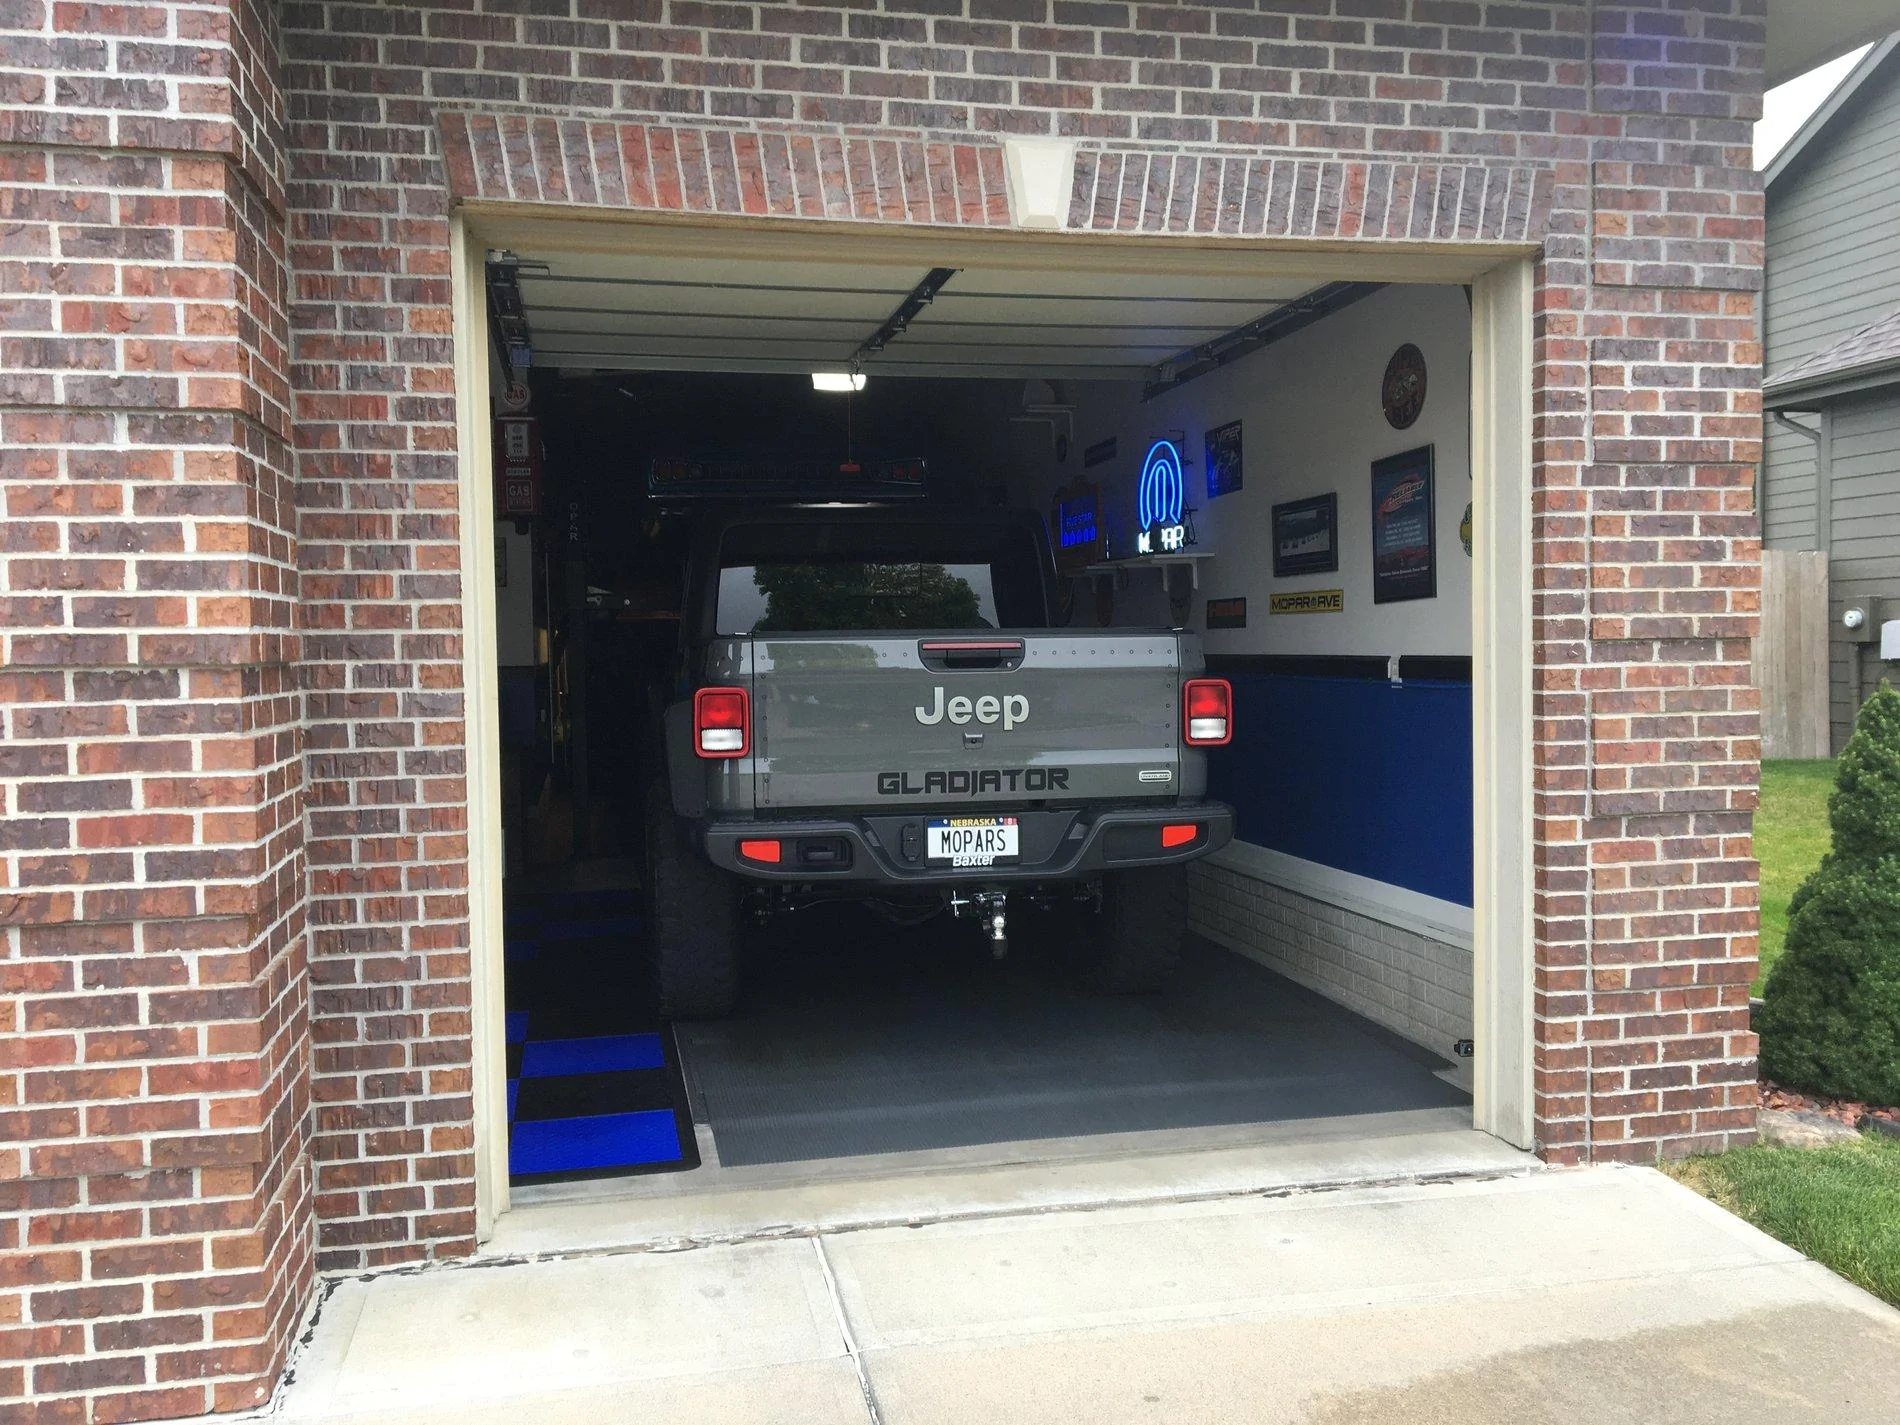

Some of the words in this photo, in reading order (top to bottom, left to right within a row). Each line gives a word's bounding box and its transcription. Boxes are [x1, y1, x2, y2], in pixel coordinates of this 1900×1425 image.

[1216, 425, 1241, 443] VIPER
[509, 486, 530, 496] GAS
[1271, 597, 1311, 611] MOPAR
[1317, 595, 1340, 608] AVE
[915, 686, 1030, 730] Jeep
[877, 768, 1070, 797] GLADIATOR
[950, 818, 997, 827] NEBRASKA
[941, 829, 1006, 854] MOPARS
[952, 854, 996, 867] Baxter
